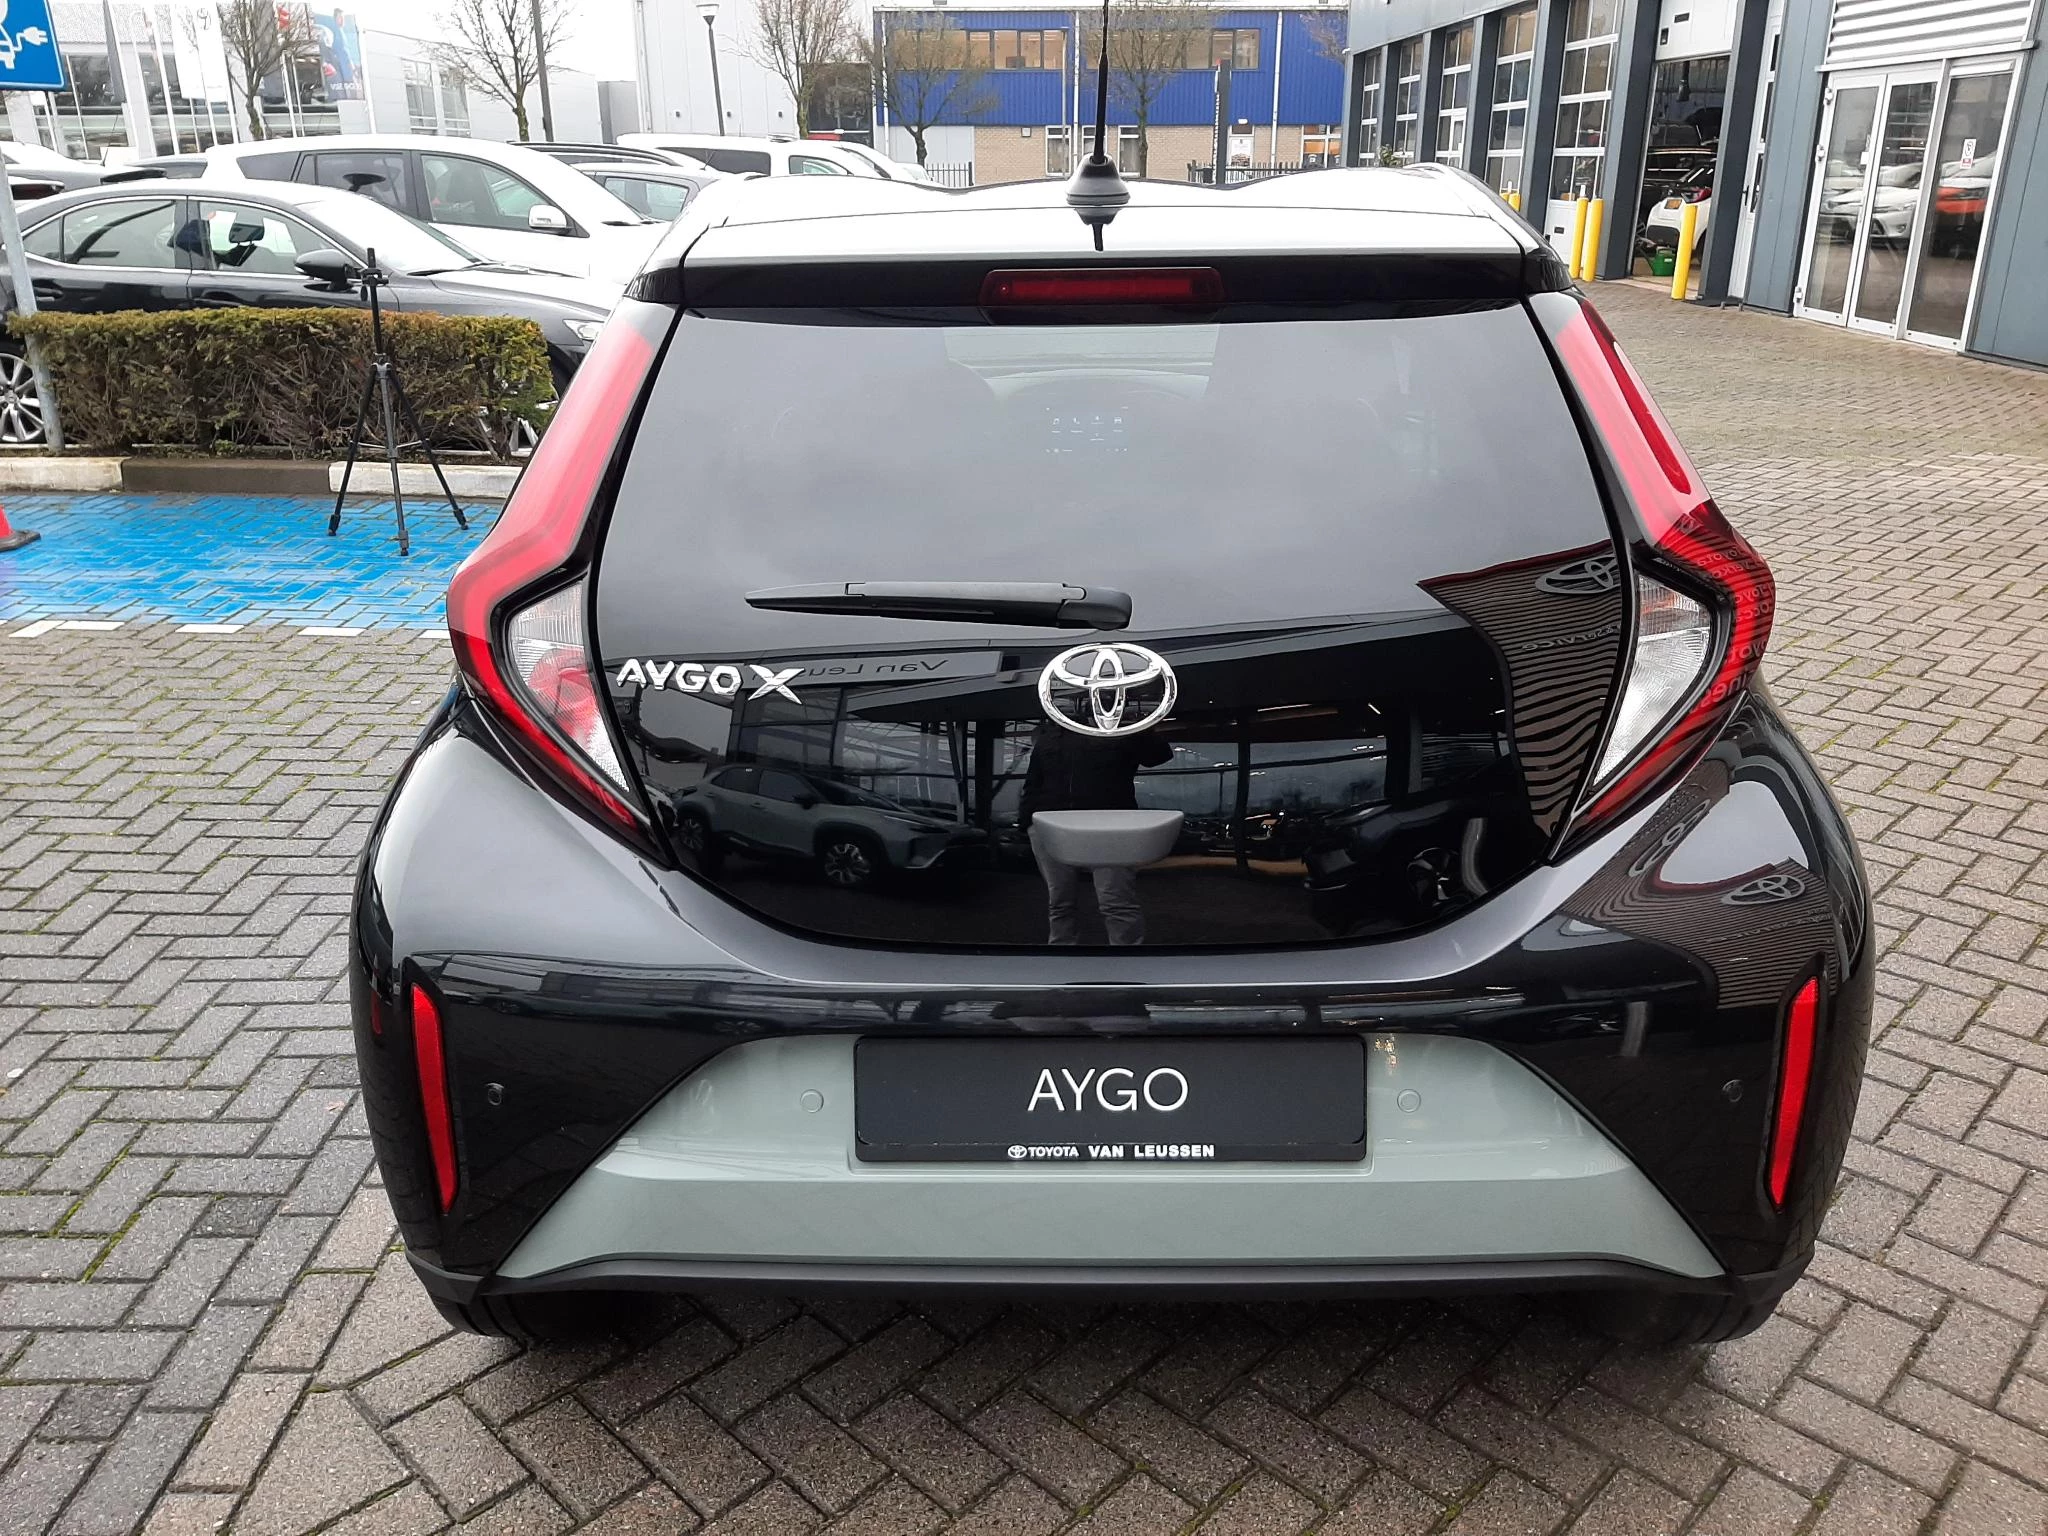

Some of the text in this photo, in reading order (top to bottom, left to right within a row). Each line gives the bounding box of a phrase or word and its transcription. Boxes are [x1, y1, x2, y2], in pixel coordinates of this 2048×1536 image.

[615, 658, 806, 705] AYGO X
[1027, 1067, 1189, 1112] AYGO
[1028, 1145, 1215, 1158] TOYOTA VAN LEUSSEN
